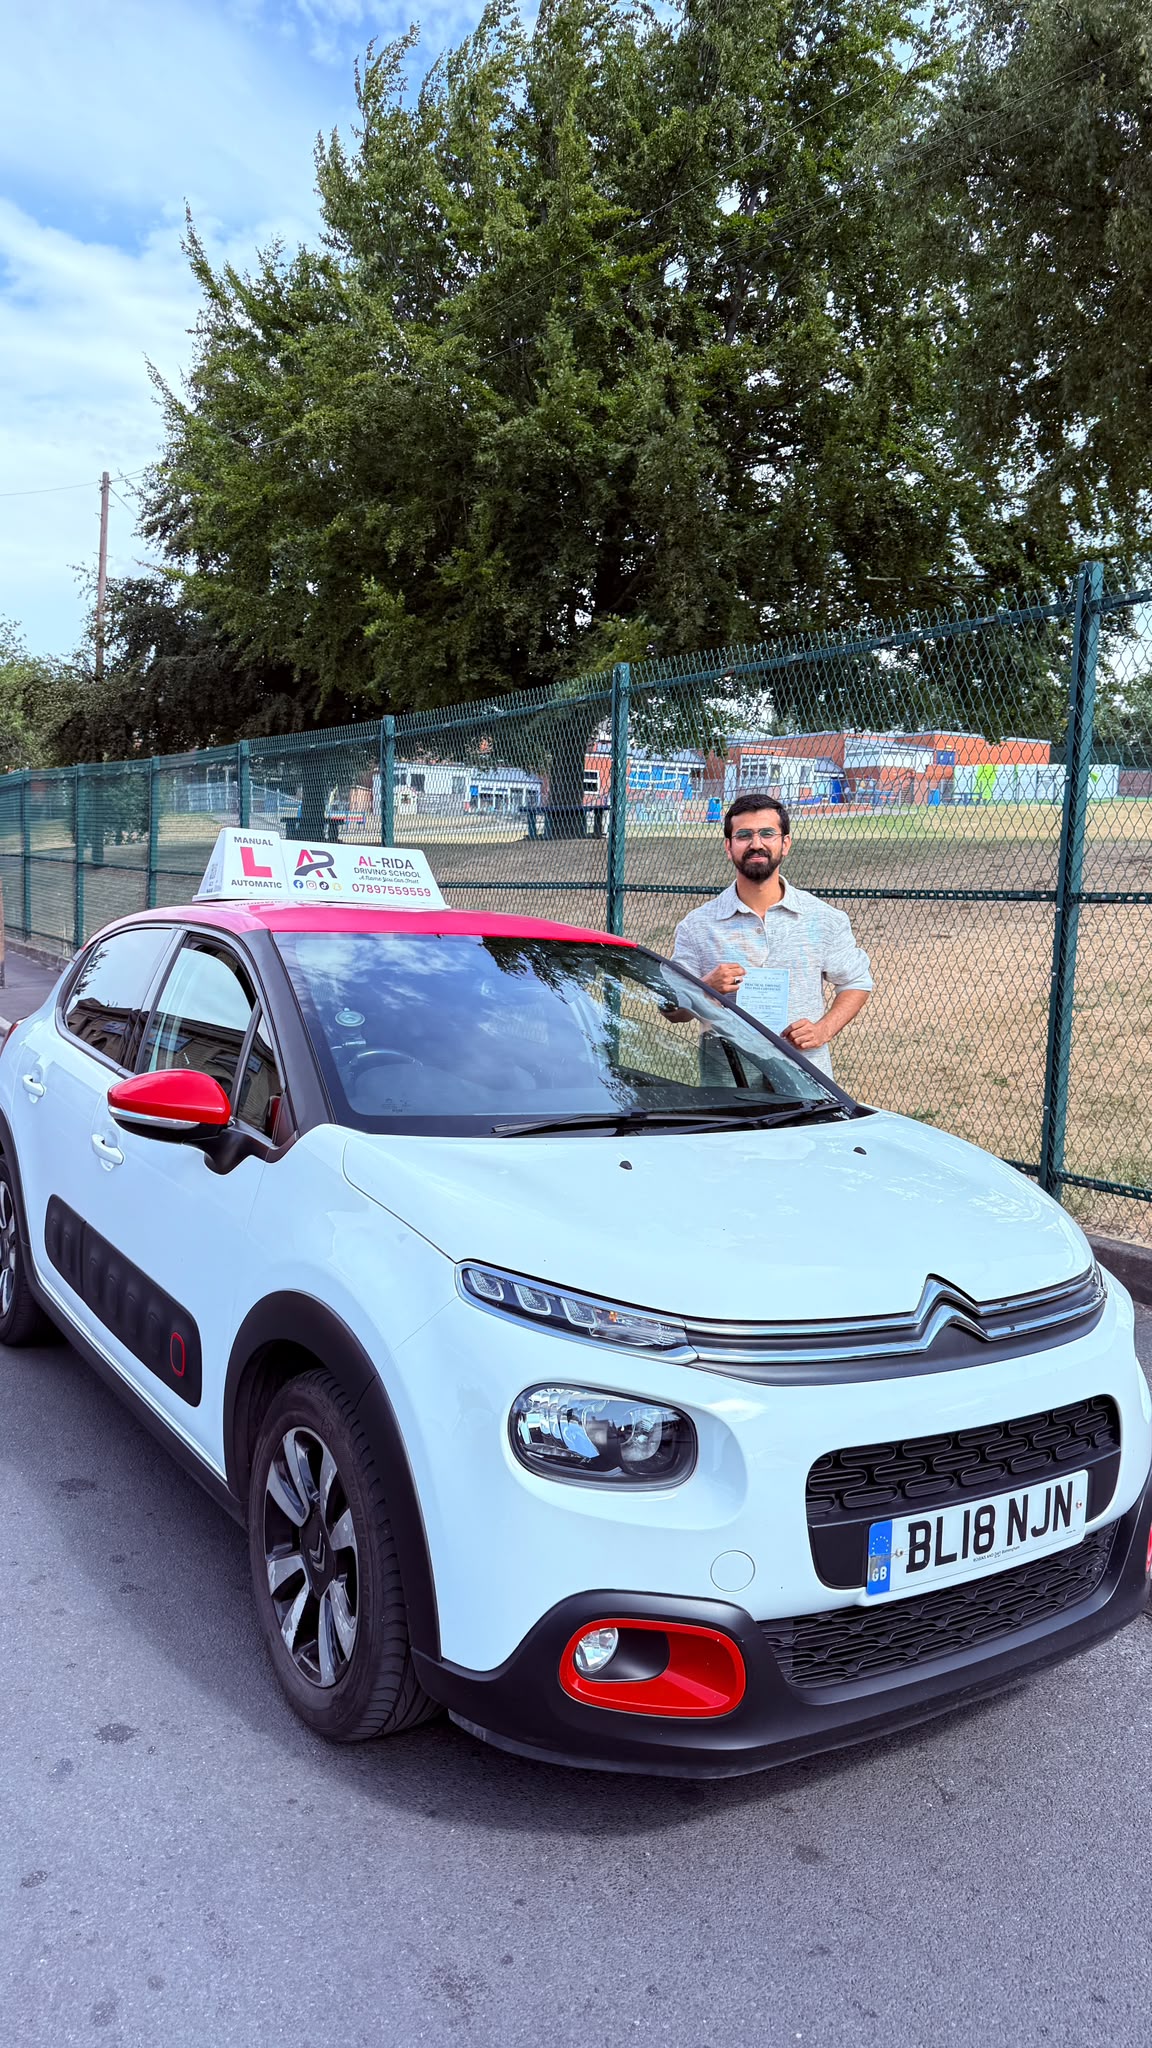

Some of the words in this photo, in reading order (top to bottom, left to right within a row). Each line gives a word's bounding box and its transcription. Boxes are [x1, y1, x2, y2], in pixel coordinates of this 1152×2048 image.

[233, 836, 274, 846] MANUAL
[240, 846, 273, 878] L
[358, 855, 414, 870] AL-RIDA
[353, 867, 388, 876] DRIVING
[388, 869, 422, 879] SCHOOL
[231, 879, 283, 889] AUTOMATIC
[351, 883, 432, 897] 07897559559
[905, 1504, 996, 1574] BL18
[1006, 1481, 1073, 1547] NJN
[871, 1565, 888, 1583] GB
